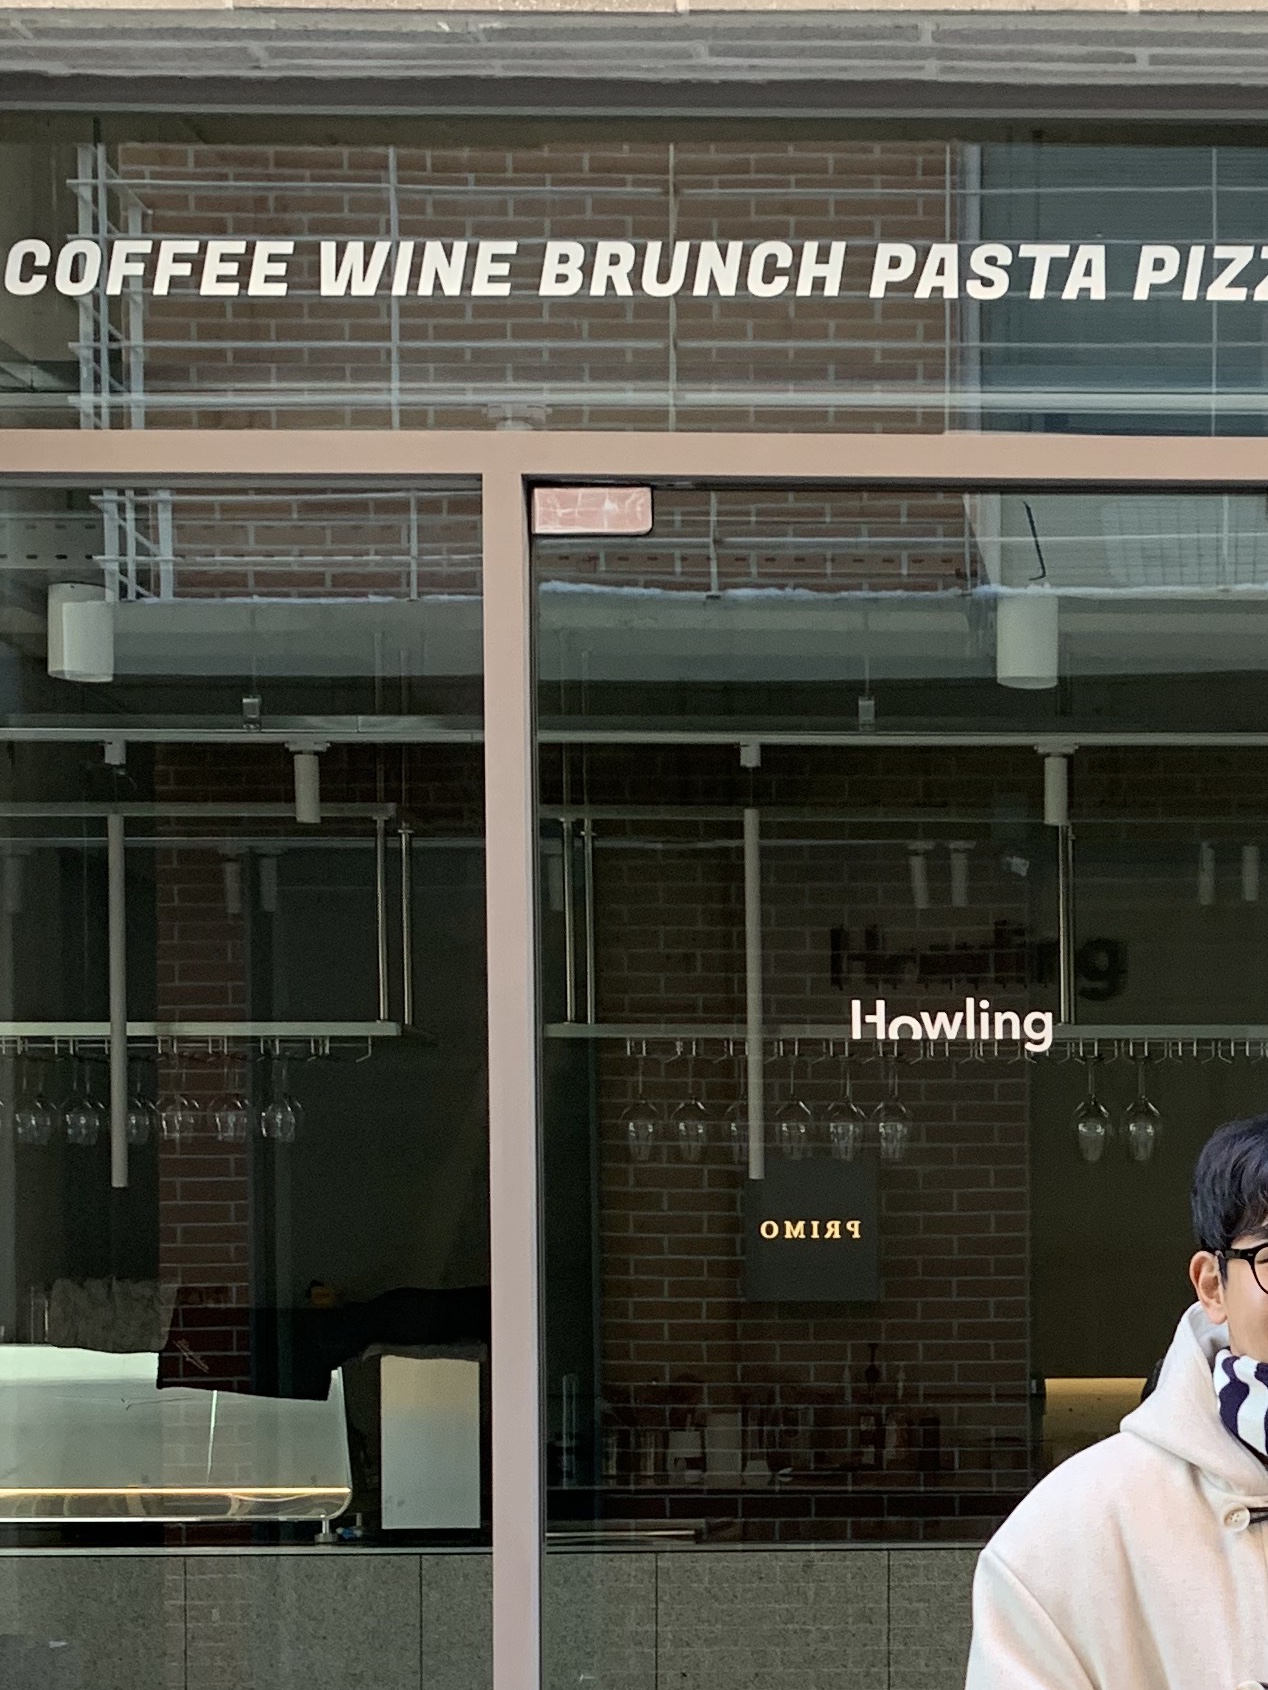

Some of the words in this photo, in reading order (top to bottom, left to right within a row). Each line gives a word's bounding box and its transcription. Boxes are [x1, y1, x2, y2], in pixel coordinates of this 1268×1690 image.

[4, 238, 295, 297] COFFEE
[319, 240, 518, 297] WINE
[537, 240, 846, 298] BRUNCH
[868, 242, 1106, 300] PASTA
[850, 997, 1053, 1053] Howling
